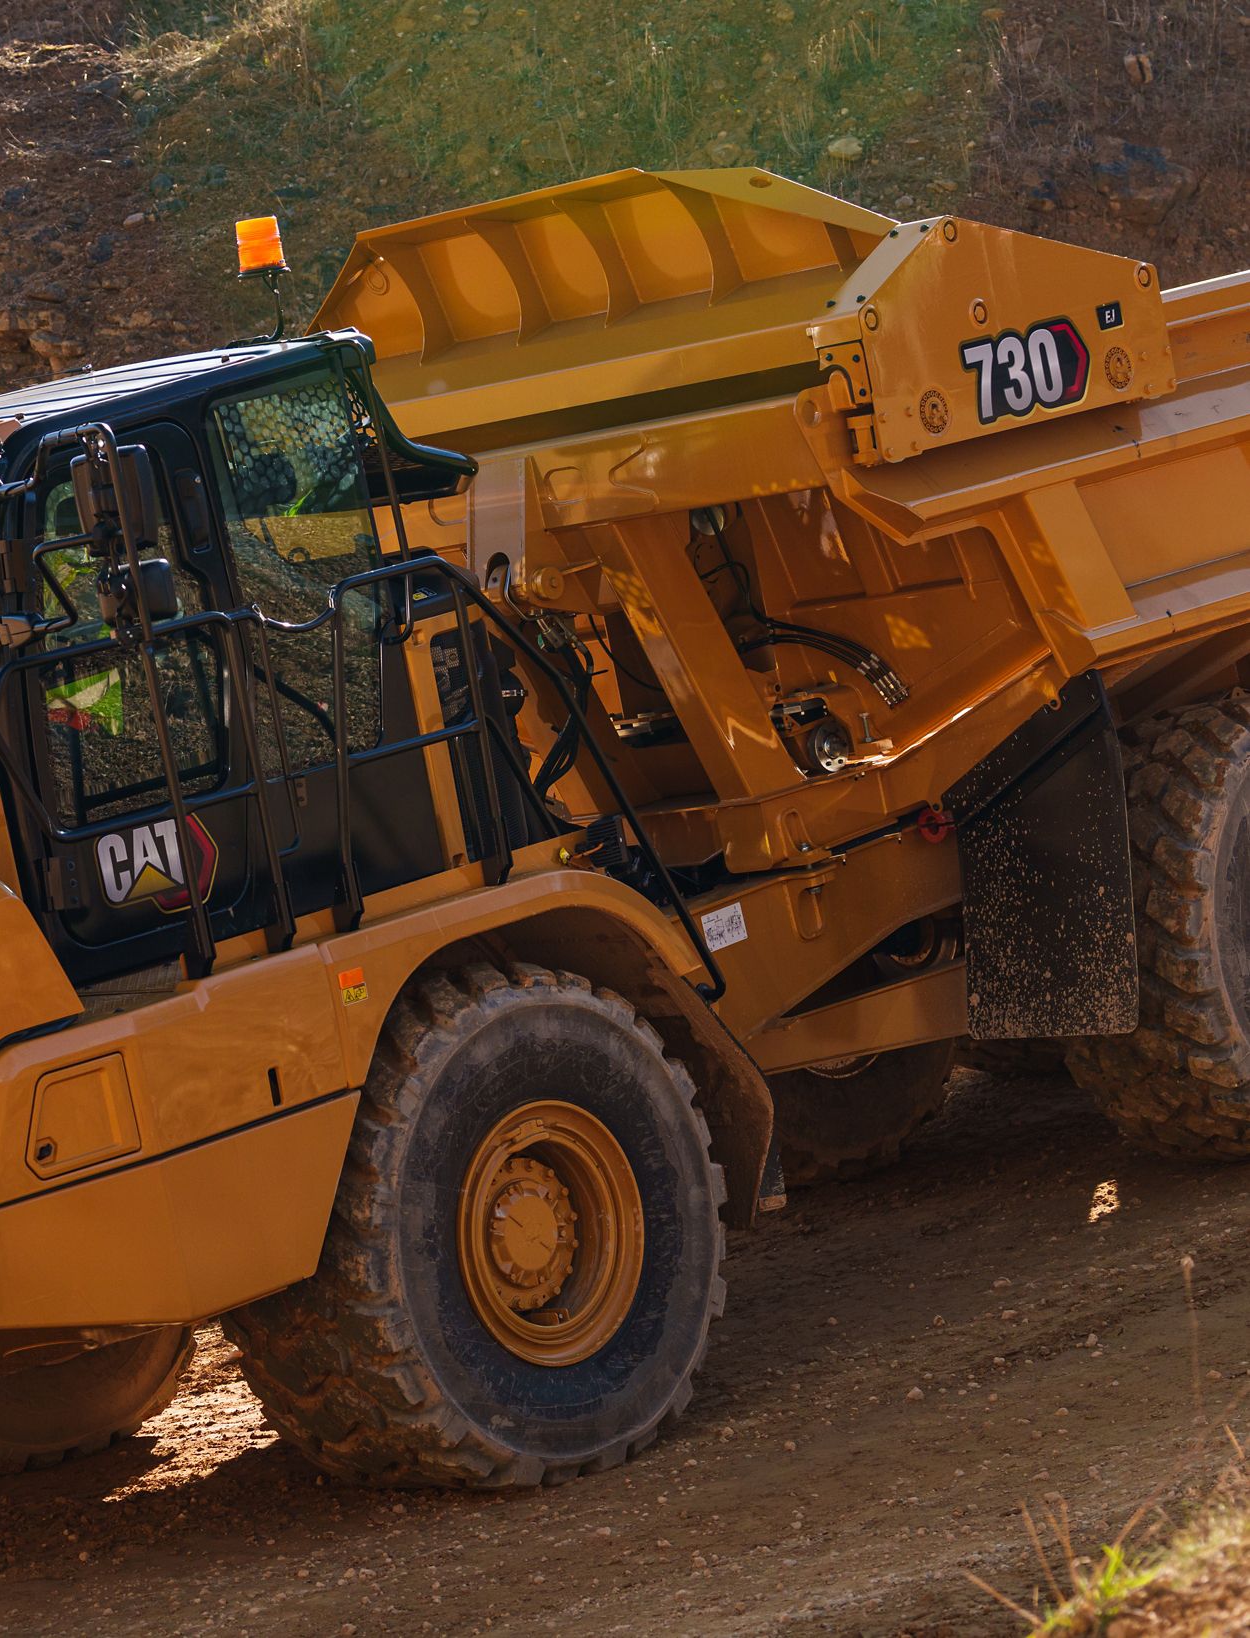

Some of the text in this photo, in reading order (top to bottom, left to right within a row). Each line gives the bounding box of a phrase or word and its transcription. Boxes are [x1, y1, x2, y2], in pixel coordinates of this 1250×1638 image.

[1104, 308, 1116, 324] EJ
[963, 328, 1063, 418] 730
[97, 819, 184, 902] CAT
